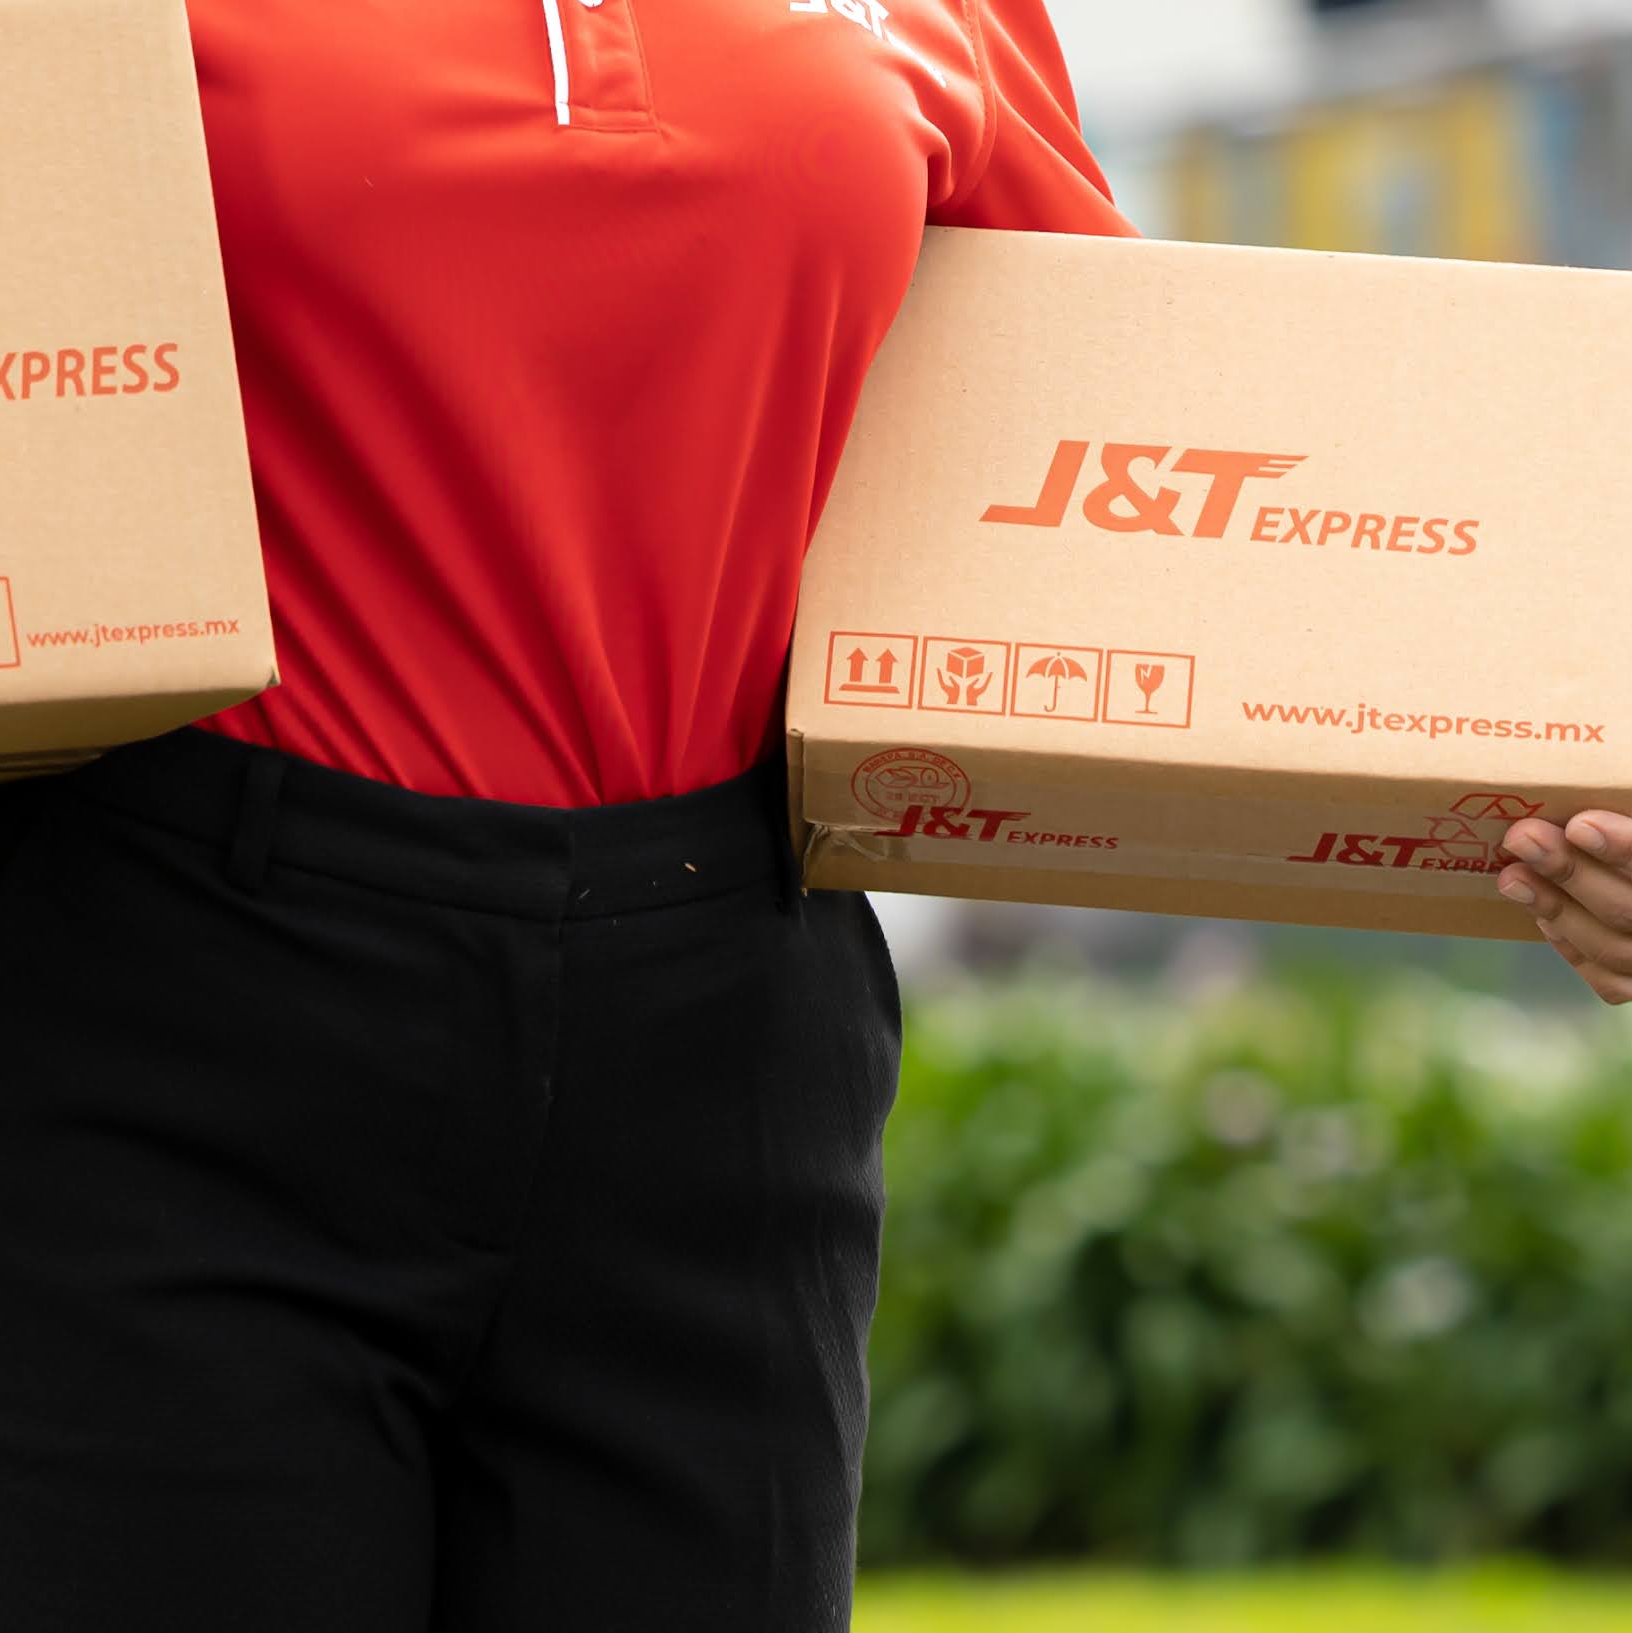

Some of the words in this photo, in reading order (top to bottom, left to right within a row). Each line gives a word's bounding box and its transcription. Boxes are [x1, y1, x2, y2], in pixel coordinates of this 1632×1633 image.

[979, 440, 1310, 539] J&T
[1250, 506, 1480, 556] EXPRESS
[26, 618, 240, 649] www.jtexpress.mx
[1241, 701, 1607, 744] www.jtexpress.mx
[873, 805, 1032, 842] J&T
[1007, 830, 1120, 850] EXPRESS
[1285, 832, 1447, 868] J&T
